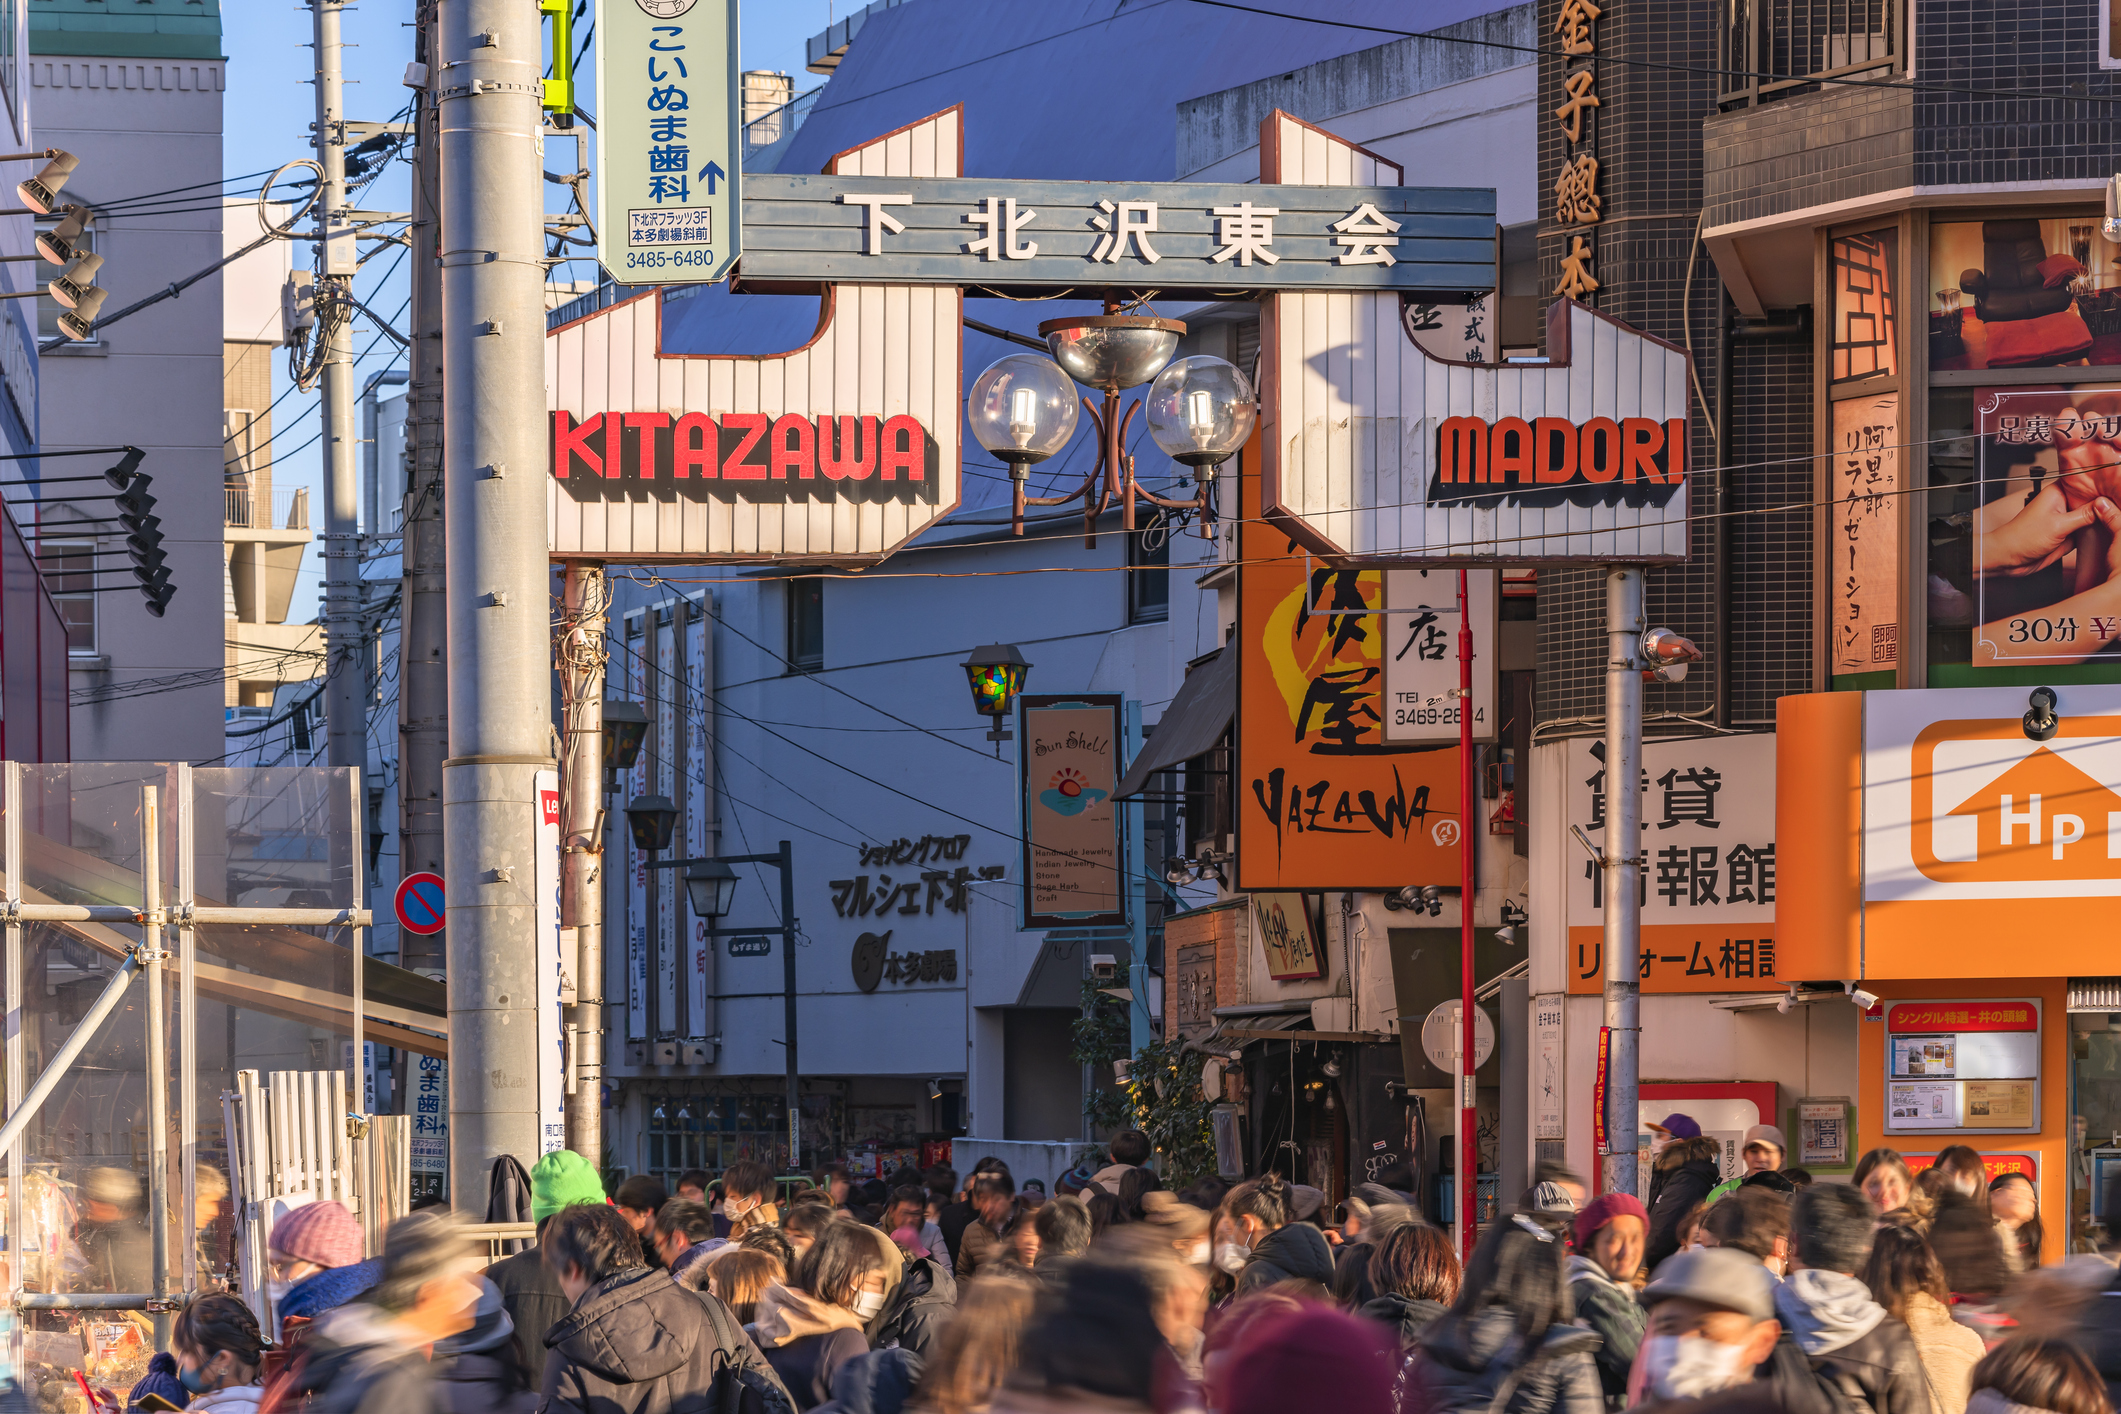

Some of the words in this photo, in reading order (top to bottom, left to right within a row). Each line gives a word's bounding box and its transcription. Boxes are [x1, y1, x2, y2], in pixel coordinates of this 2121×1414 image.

[647, 26, 691, 204] こいぬま歯科
[631, 210, 708, 227] 下北沢フラッツ3F
[631, 227, 708, 243] 本多劇場斜前
[843, 193, 1402, 268] 下北沢東会
[626, 249, 714, 269] 3485-6480
[553, 410, 926, 482] KITAZAWA
[1438, 415, 1685, 485] MADORI
[1863, 425, 1886, 518] 阿里郎
[1886, 425, 1895, 511] アリラン
[1395, 604, 1448, 662] 店
[2008, 617, 2080, 643] 30分
[1395, 706, 1485, 726] 3469-284
[1425, 696, 1443, 707] 2m
[1034, 738, 1063, 757] Sun
[1065, 730, 1109, 756] Shell
[1252, 763, 1461, 870] YAZAWA
[2000, 793, 2121, 861] HP
[859, 834, 971, 867] ショッピングフロア
[1035, 848, 1079, 857] Handmade
[1081, 848, 1113, 858] Jewelry
[1035, 861, 1062, 869] Indian
[1064, 860, 1096, 869] Jewelry
[1035, 872, 1060, 880] Stone
[1035, 884, 1053, 892] Sage
[1059, 881, 1080, 891] Harb
[1036, 895, 1058, 903] Craft
[884, 948, 958, 984] 本多劇場
[1578, 937, 1776, 980] リォーム相
[1595, 1031, 1608, 1140] 防犯カメラ作動中
[411, 1139, 445, 1148] 北沢フラッツ3F
[1725, 1139, 1736, 1181] 賃貸マンシ
